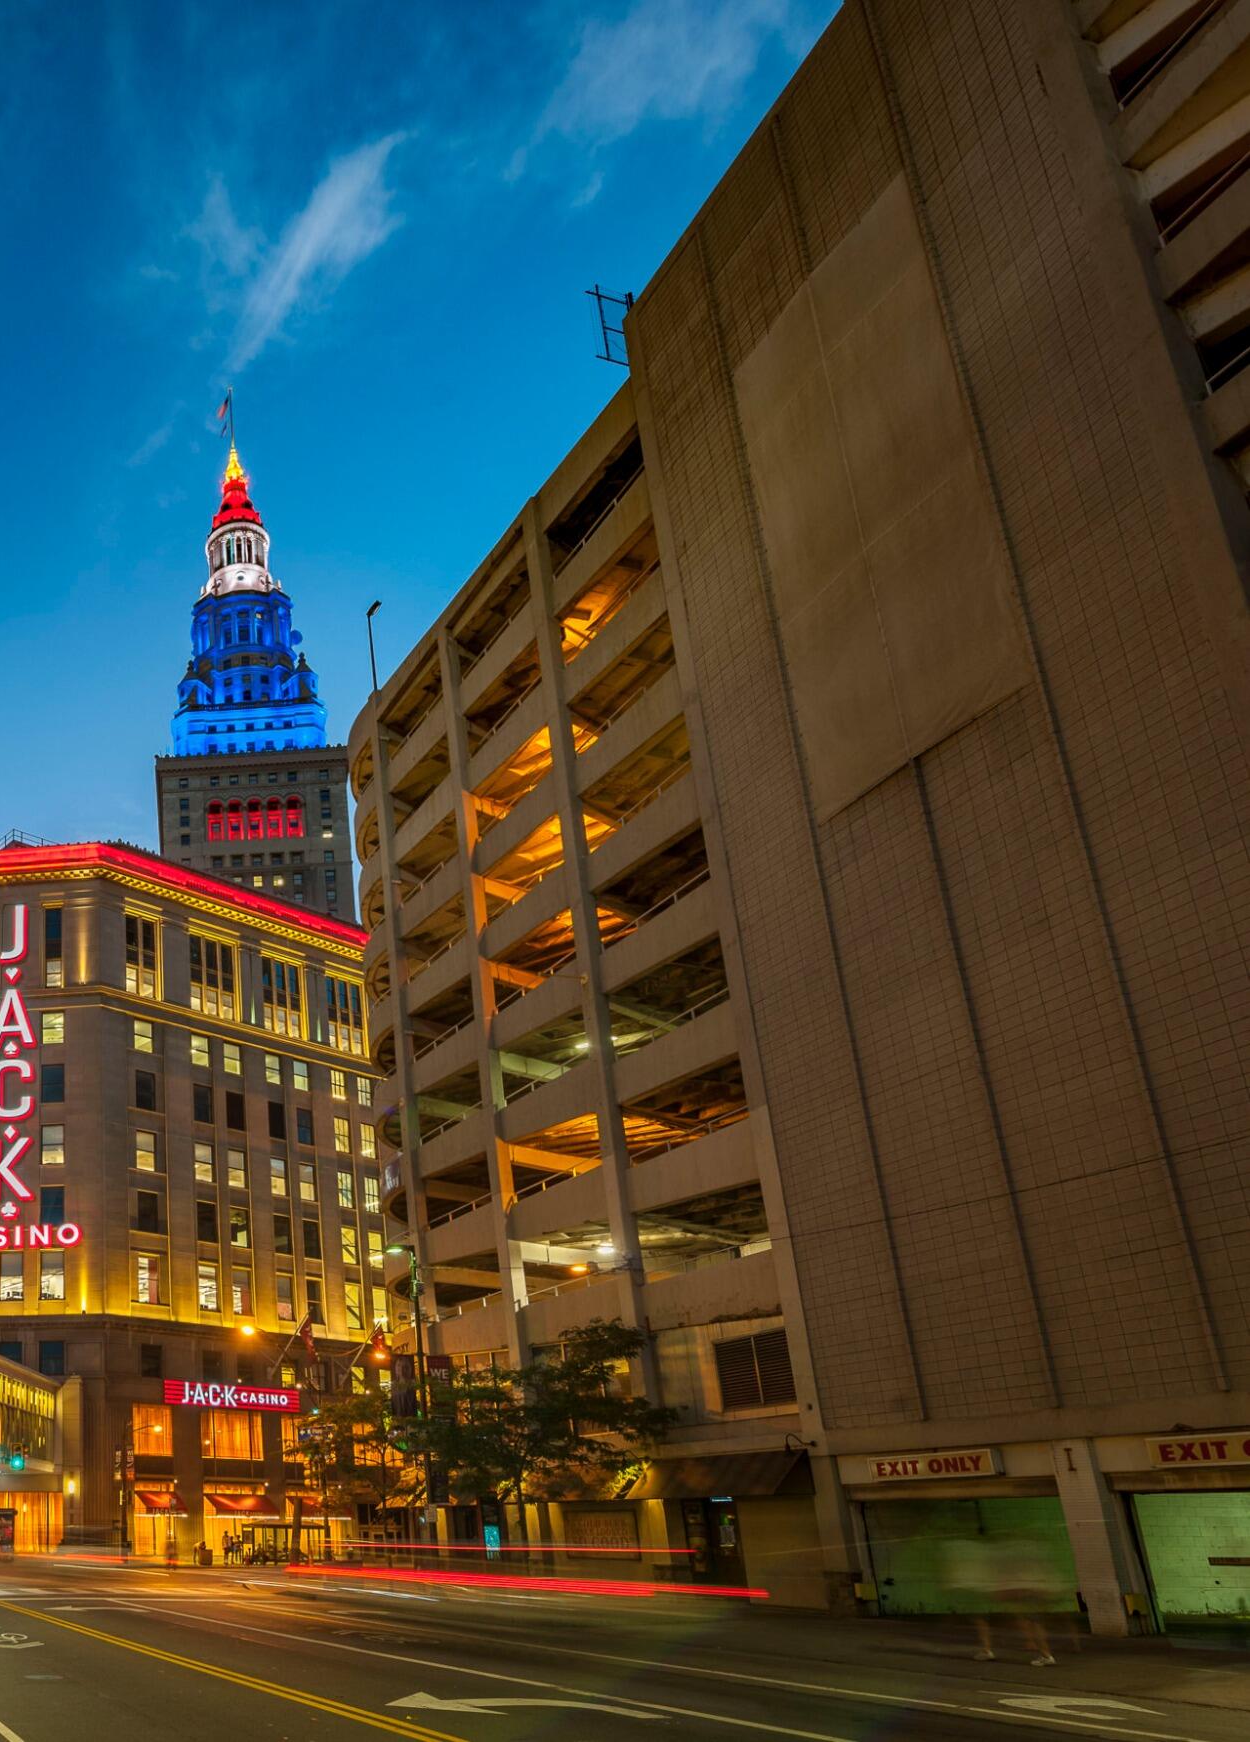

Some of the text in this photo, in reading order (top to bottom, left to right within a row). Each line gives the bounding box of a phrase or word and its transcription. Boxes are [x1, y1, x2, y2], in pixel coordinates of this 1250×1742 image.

[430, 1367, 450, 1380] WE
[182, 1381, 288, 1407] JACK CASINO
[1157, 1440, 1229, 1462] EXIT
[876, 1455, 982, 1477] EXIT ONLY
